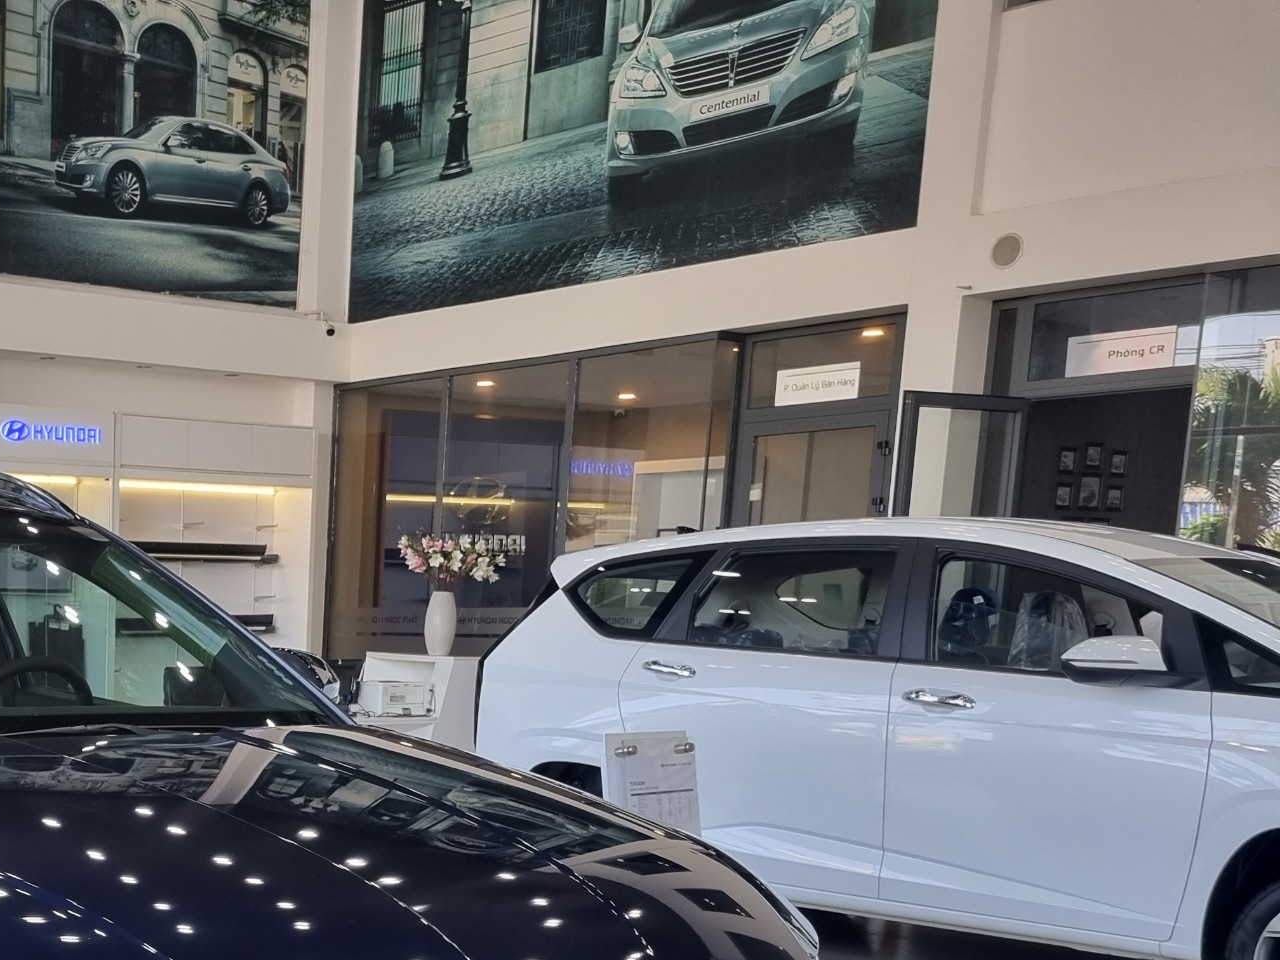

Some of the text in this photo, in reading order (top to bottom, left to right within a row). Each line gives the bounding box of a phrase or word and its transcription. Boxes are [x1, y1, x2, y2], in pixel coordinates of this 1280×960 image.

[699, 90, 761, 115] Centennial
[1107, 344, 1165, 359] Phòng CR
[31, 424, 102, 445] HYUNDAI
